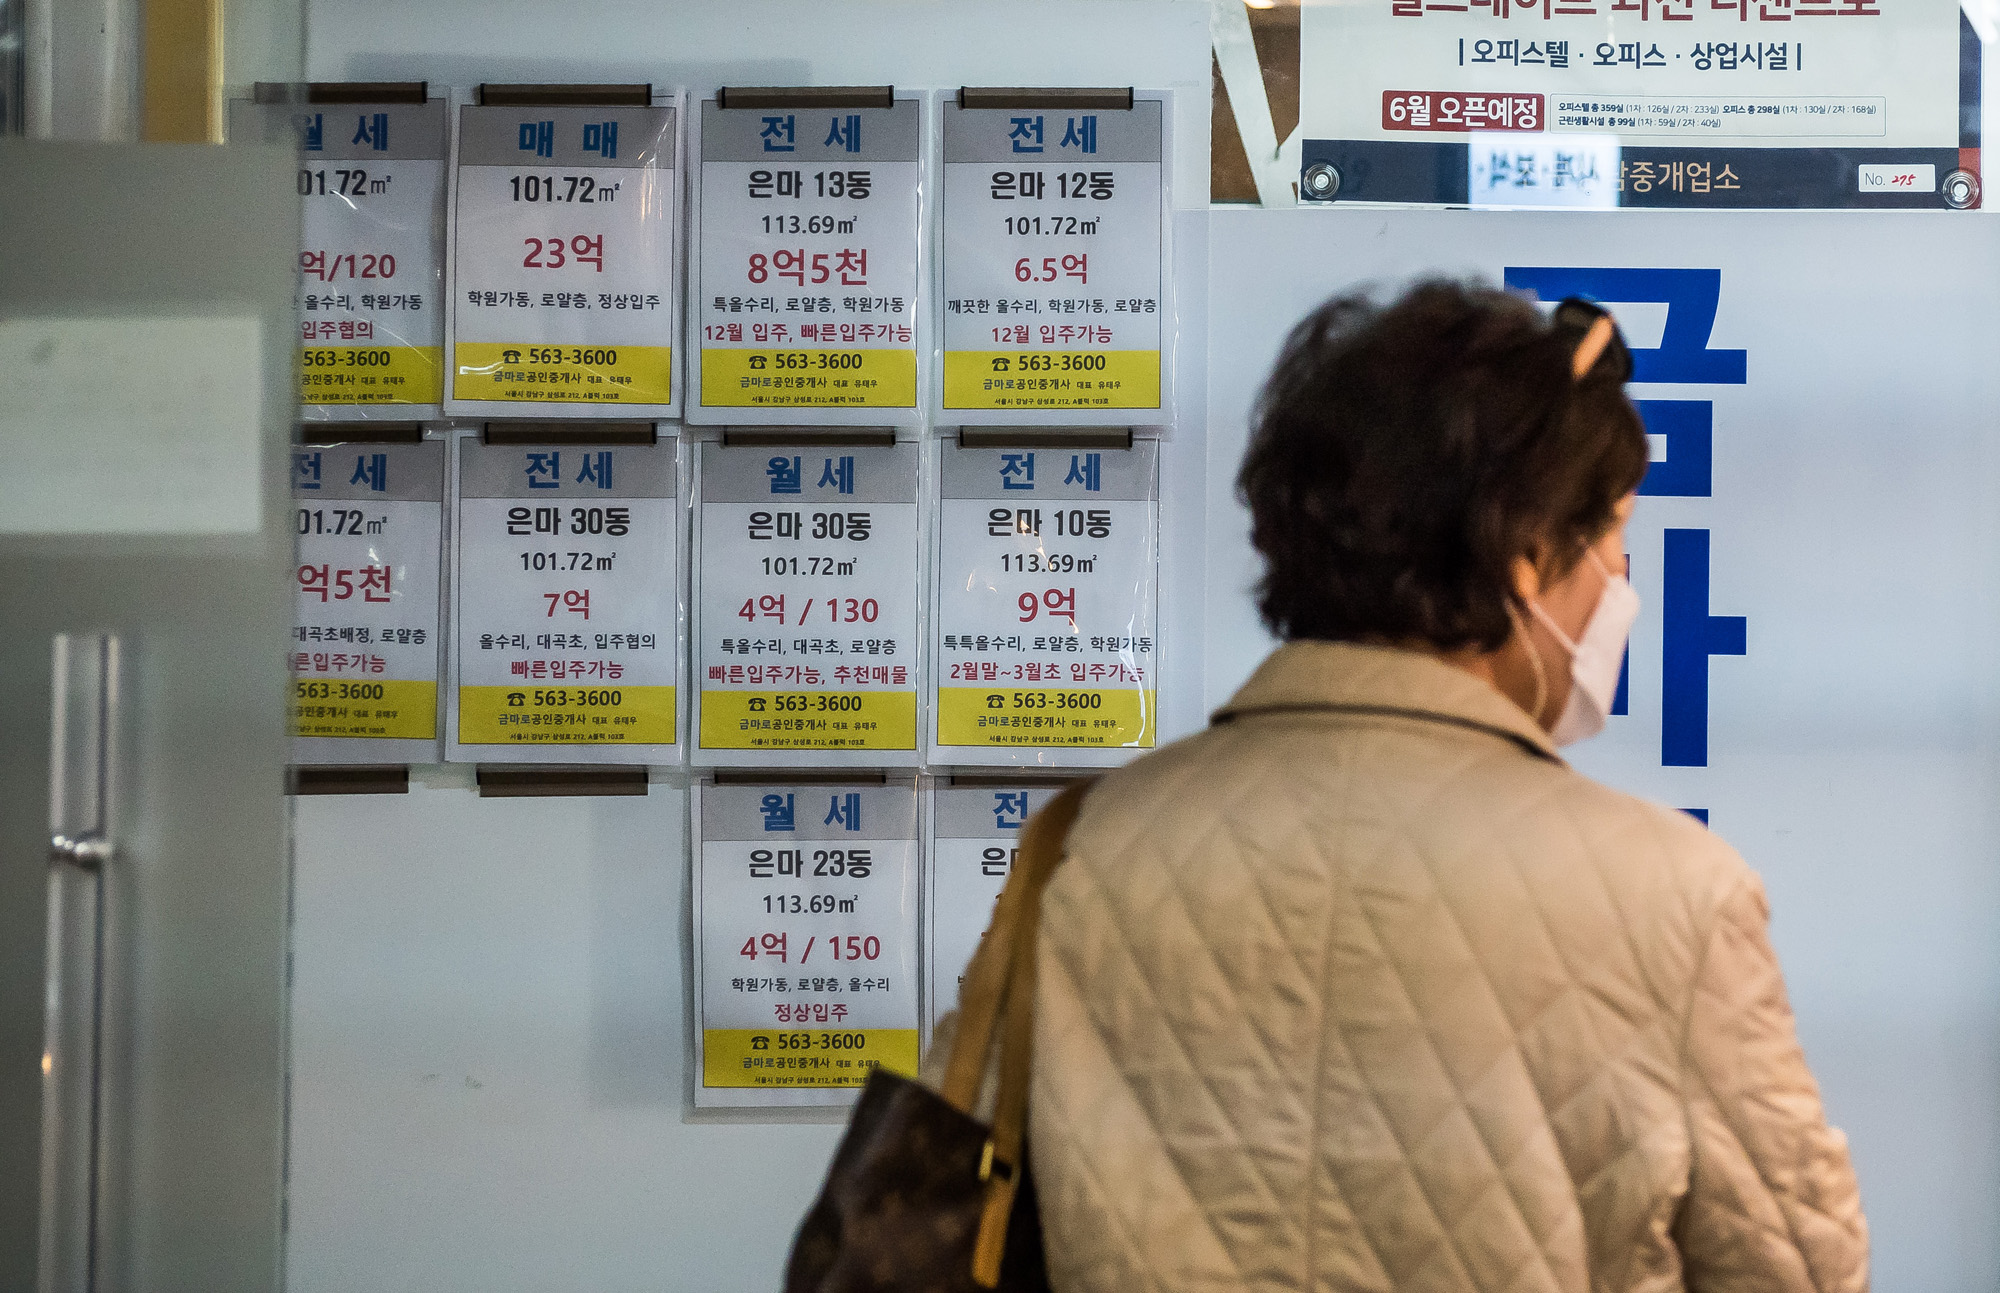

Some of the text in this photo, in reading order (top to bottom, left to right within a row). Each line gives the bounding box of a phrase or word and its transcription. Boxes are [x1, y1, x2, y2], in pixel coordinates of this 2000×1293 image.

[1471, 39, 1787, 71] 오피스텔 오피스 상업시설
[1390, 95, 1537, 129] 6월 오픈예정
[1558, 103, 1589, 112] 오피스텔
[1601, 104, 1623, 113] 359실
[1723, 105, 1745, 114] 오피스
[1757, 105, 1780, 114] 298실
[1558, 117, 1604, 126] 근린생활시설
[1618, 118, 1635, 126] 99실
[352, 114, 388, 150] 세
[519, 121, 617, 159] 매 매
[760, 115, 861, 152] 전 세
[1008, 116, 1097, 153] 전 세
[297, 170, 391, 195] 01.72㎡
[748, 171, 871, 199] 은마 13동
[991, 172, 1114, 200] 은마 12동
[1865, 172, 1885, 186] No.
[523, 234, 604, 273] 23억
[300, 251, 396, 282] 억/120
[748, 248, 868, 286] 8억5천
[1015, 254, 1087, 285] 6.5억
[305, 295, 422, 311] 올수리, 학원가동
[468, 291, 660, 310] 학원가동, 로얄층, 정상입주
[713, 297, 904, 313] 특올수리, 로얄층, 학원가동
[948, 299, 1156, 314] 깨끗한 올수리, 학원가동, 로얄층
[302, 321, 373, 339] 입주협의
[705, 324, 912, 343] 12월 입주, 빠른입주가능
[992, 325, 1113, 344] 12월 입주가능
[303, 351, 390, 366] 563-3600
[530, 349, 617, 365] 563-3600
[775, 354, 862, 369] 563-3600
[1018, 356, 1106, 371] 563-3600
[740, 377, 827, 388] 금마로공인중개사
[833, 380, 848, 388] 대표
[983, 379, 1070, 390] 금마로공인중개사
[349, 454, 387, 491] 세
[525, 451, 612, 489] 전 세
[766, 456, 854, 494] 월 세
[1000, 453, 1100, 491] 전 세
[298, 509, 387, 535] 01.72㎡
[507, 507, 630, 536] 은마 30동
[748, 512, 871, 541] 은마 30동
[988, 509, 1111, 538] 은마 10동
[298, 564, 391, 603] 억5천
[543, 589, 590, 620] 7억
[738, 594, 785, 625] 4억
[827, 598, 879, 623] 130
[1018, 588, 1075, 625] 9억
[380, 629, 427, 644] 로얄층
[479, 634, 656, 650] 올수리, 대곡초, 입주협의
[944, 635, 1153, 653] 특특올수리, 로얄층, 학원가동
[721, 639, 897, 655] 특올수리, 대곡초, 로얄층
[512, 660, 625, 679] 빠른입주가능
[708, 666, 908, 685] 빠른입주가능, 추천매물
[950, 663, 1061, 681] 2월말~3월초
[297, 683, 384, 700] 563-3600
[534, 691, 621, 706] 563-3600
[1013, 693, 1102, 709] 563-3600
[775, 696, 861, 712] 563-3600
[498, 714, 586, 725] 금마로공인중개사
[592, 717, 607, 725] 대표
[740, 719, 826, 731] 금마로공인중개사
[977, 716, 1066, 728] 금마로공인중개사
[760, 794, 860, 831] 월 세
[993, 792, 1028, 829] 전
[749, 850, 872, 878] 은마 23동
[740, 932, 787, 964] 4억
[829, 936, 880, 960] 150
[732, 978, 890, 993] 학원가동, 로얄층, 올수리
[774, 1004, 848, 1022] 정상입주
[778, 1034, 865, 1049] 563-3600
[743, 1057, 830, 1069] 금마로공인중개사
[836, 1060, 851, 1068] 대표
